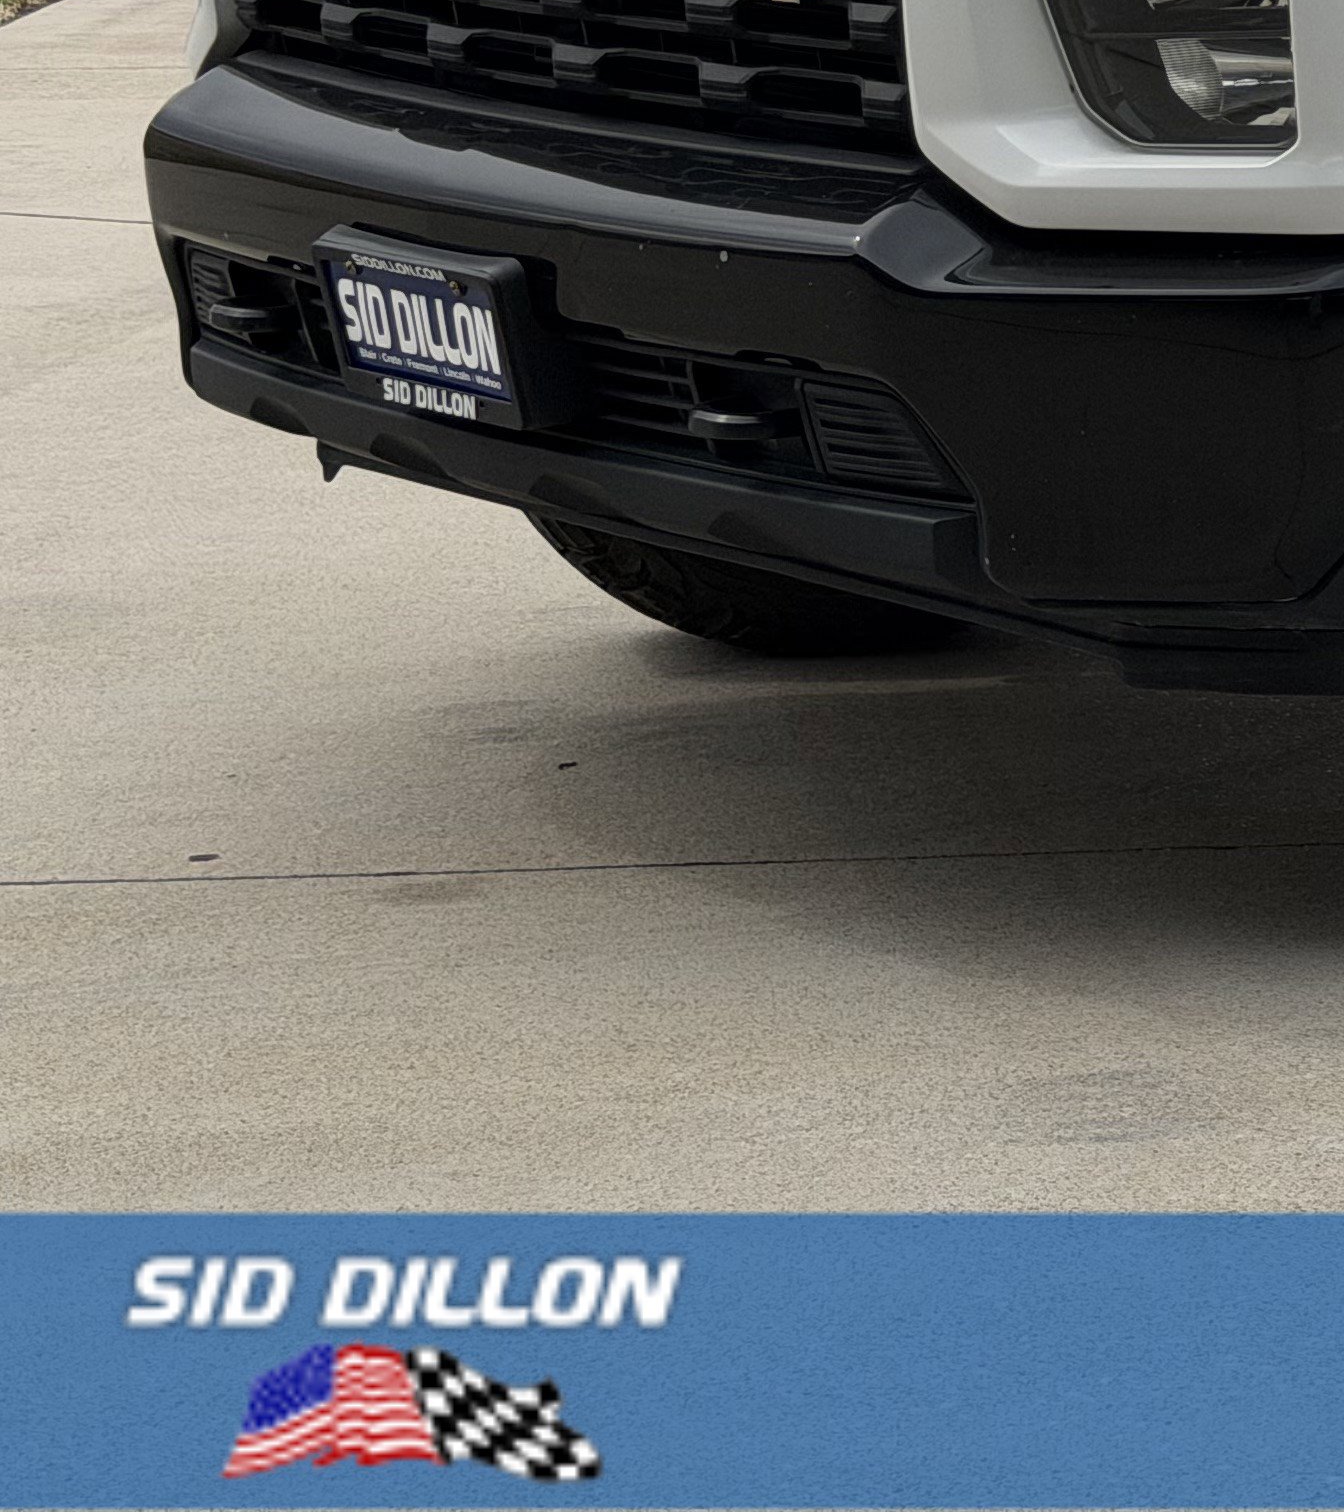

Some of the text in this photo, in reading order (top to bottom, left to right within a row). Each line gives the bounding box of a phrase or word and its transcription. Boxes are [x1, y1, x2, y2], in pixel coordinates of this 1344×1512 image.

[350, 253, 447, 282] SIDDILLON.COM
[337, 278, 502, 376] SID DILLON
[382, 377, 477, 420] SID DILLON
